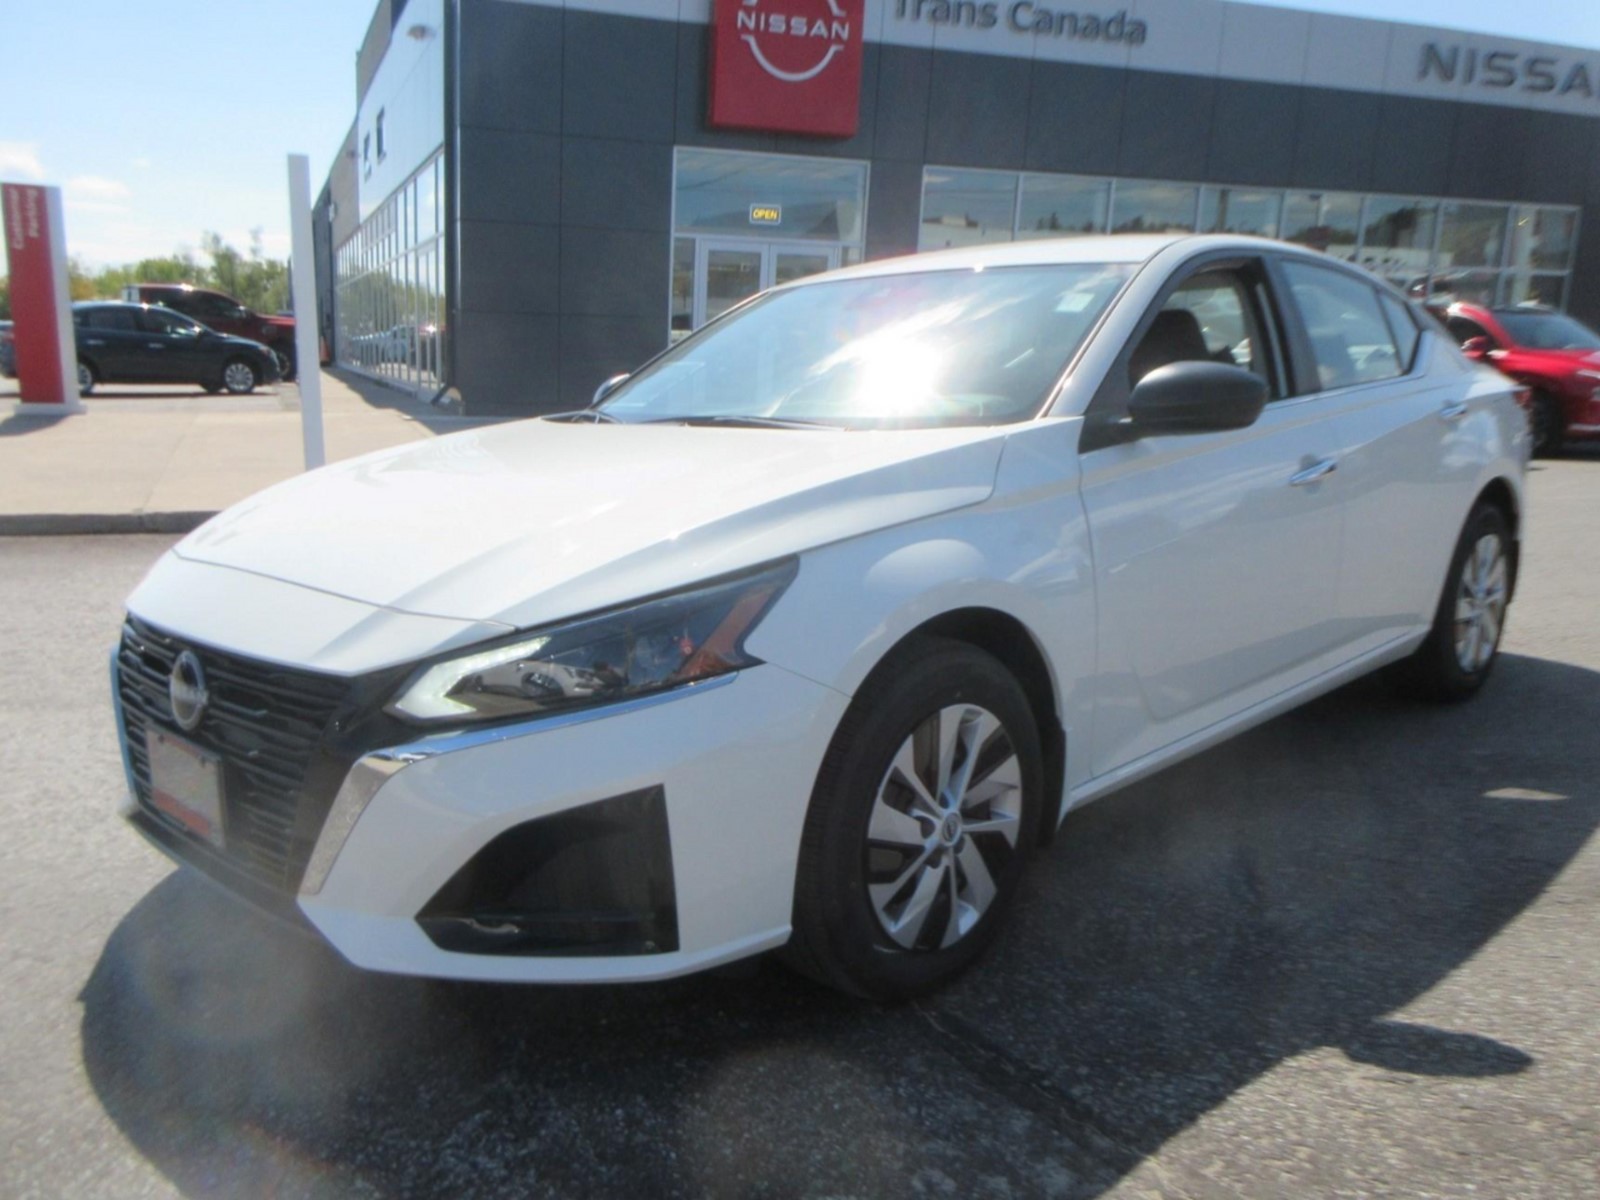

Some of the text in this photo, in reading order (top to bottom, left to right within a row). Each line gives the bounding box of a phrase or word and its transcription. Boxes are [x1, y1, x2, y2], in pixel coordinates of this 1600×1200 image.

[737, 9, 849, 41] NISSAN
[1007, 0, 1147, 45] Canada
[1417, 42, 1600, 98] NISSA
[752, 208, 778, 220] OPEN
